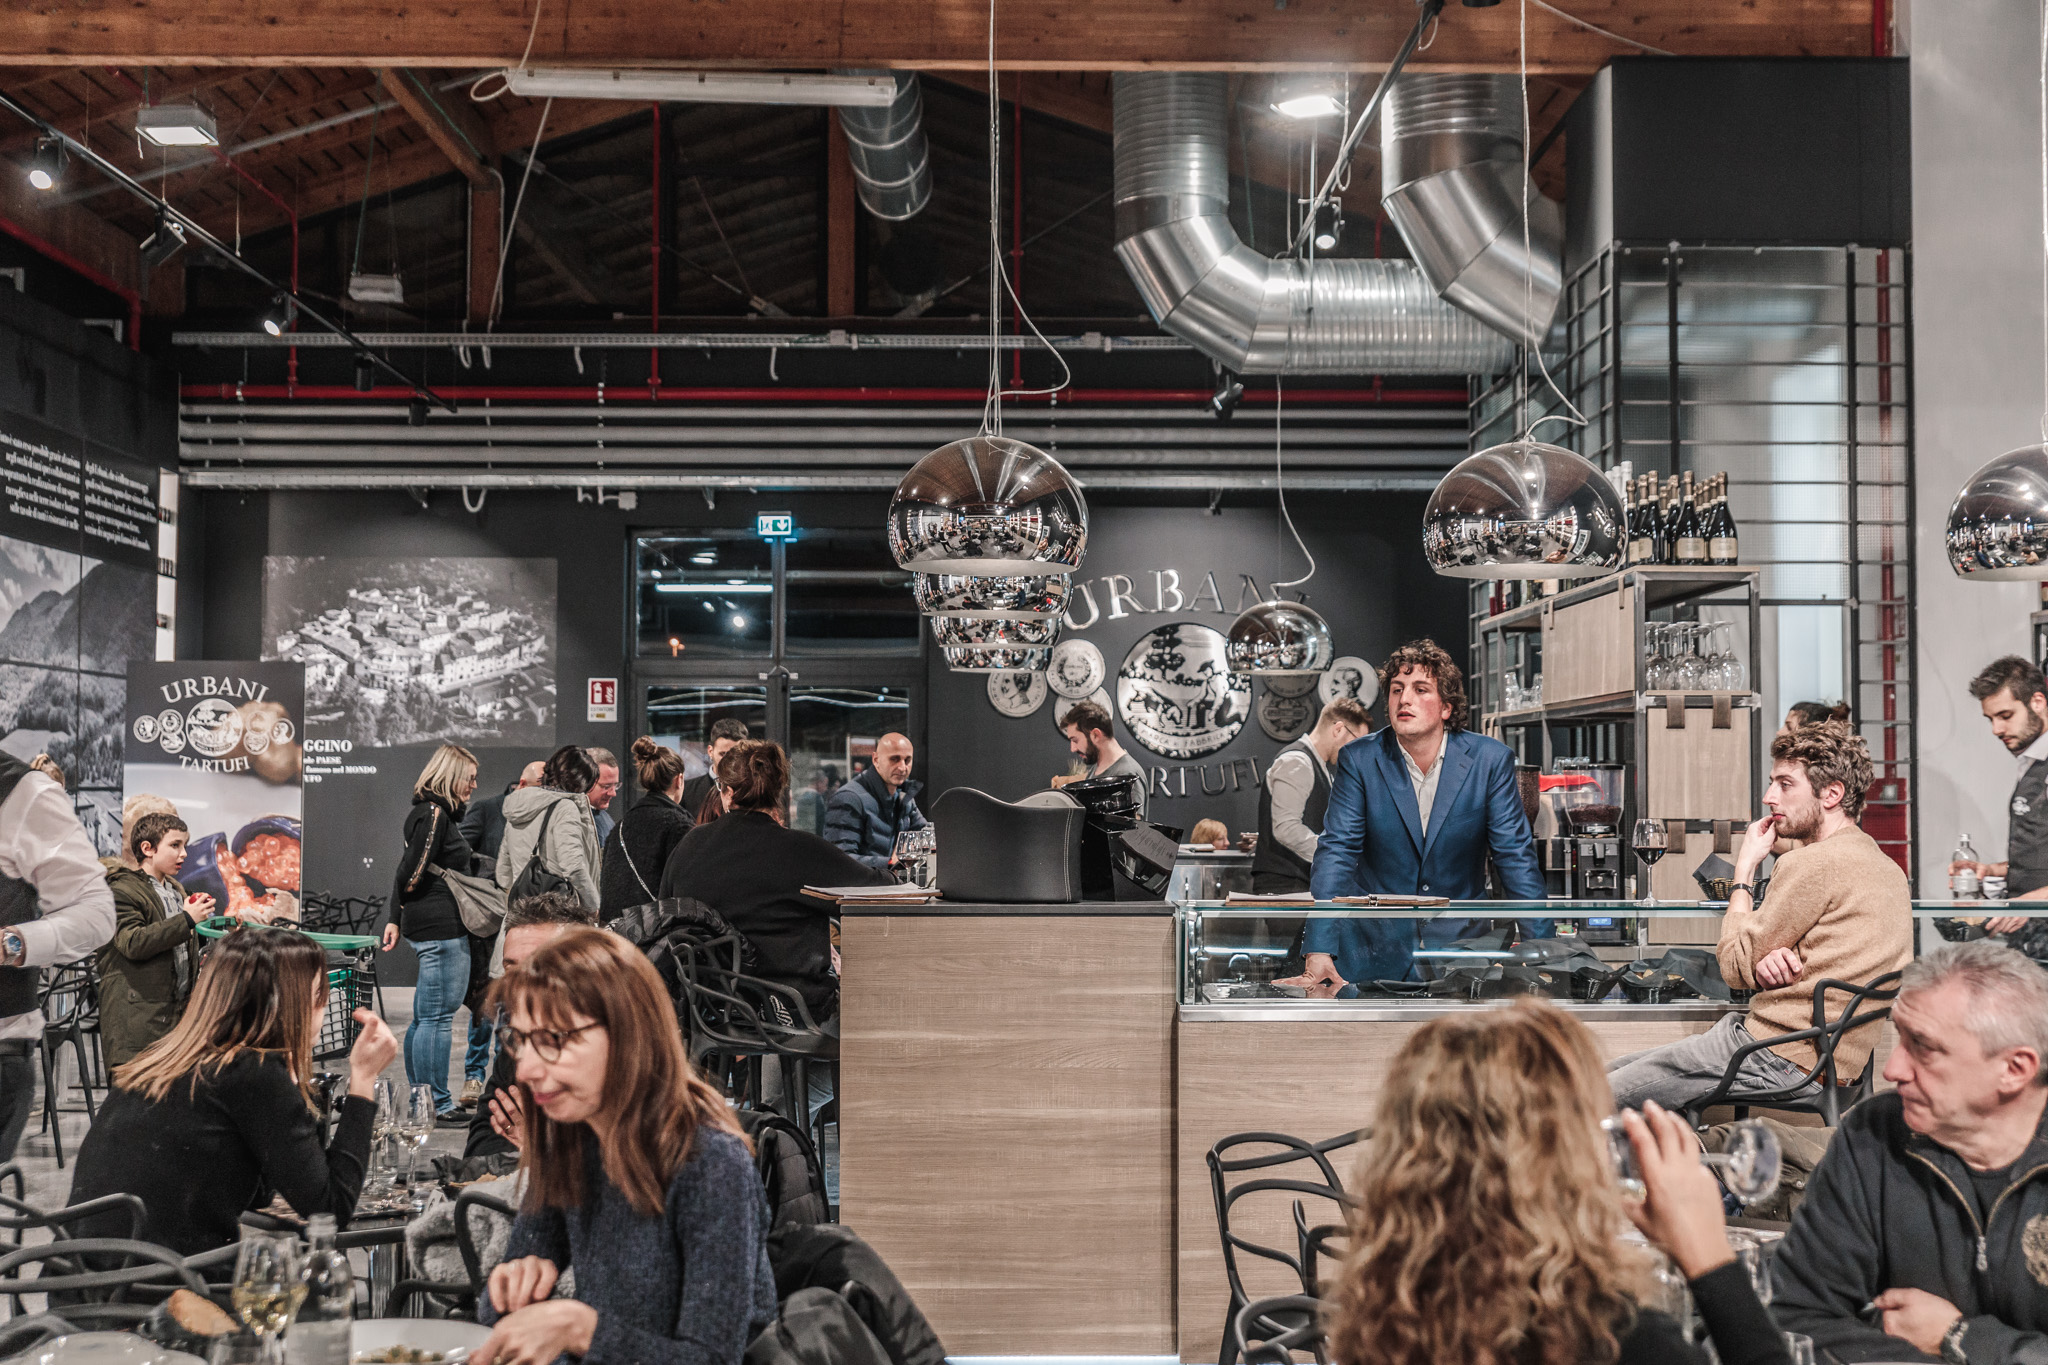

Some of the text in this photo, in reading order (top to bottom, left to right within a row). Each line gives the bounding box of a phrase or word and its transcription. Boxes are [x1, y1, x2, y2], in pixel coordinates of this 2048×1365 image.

[1063, 569, 1311, 631] URBAN
[159, 676, 270, 703] URBANI
[303, 739, 353, 753] GGINO
[179, 755, 250, 773] TARTUFI
[316, 756, 342, 764] PAESE
[306, 765, 377, 774] famoso nel MONDO
[1149, 756, 1262, 798] RTUFI
